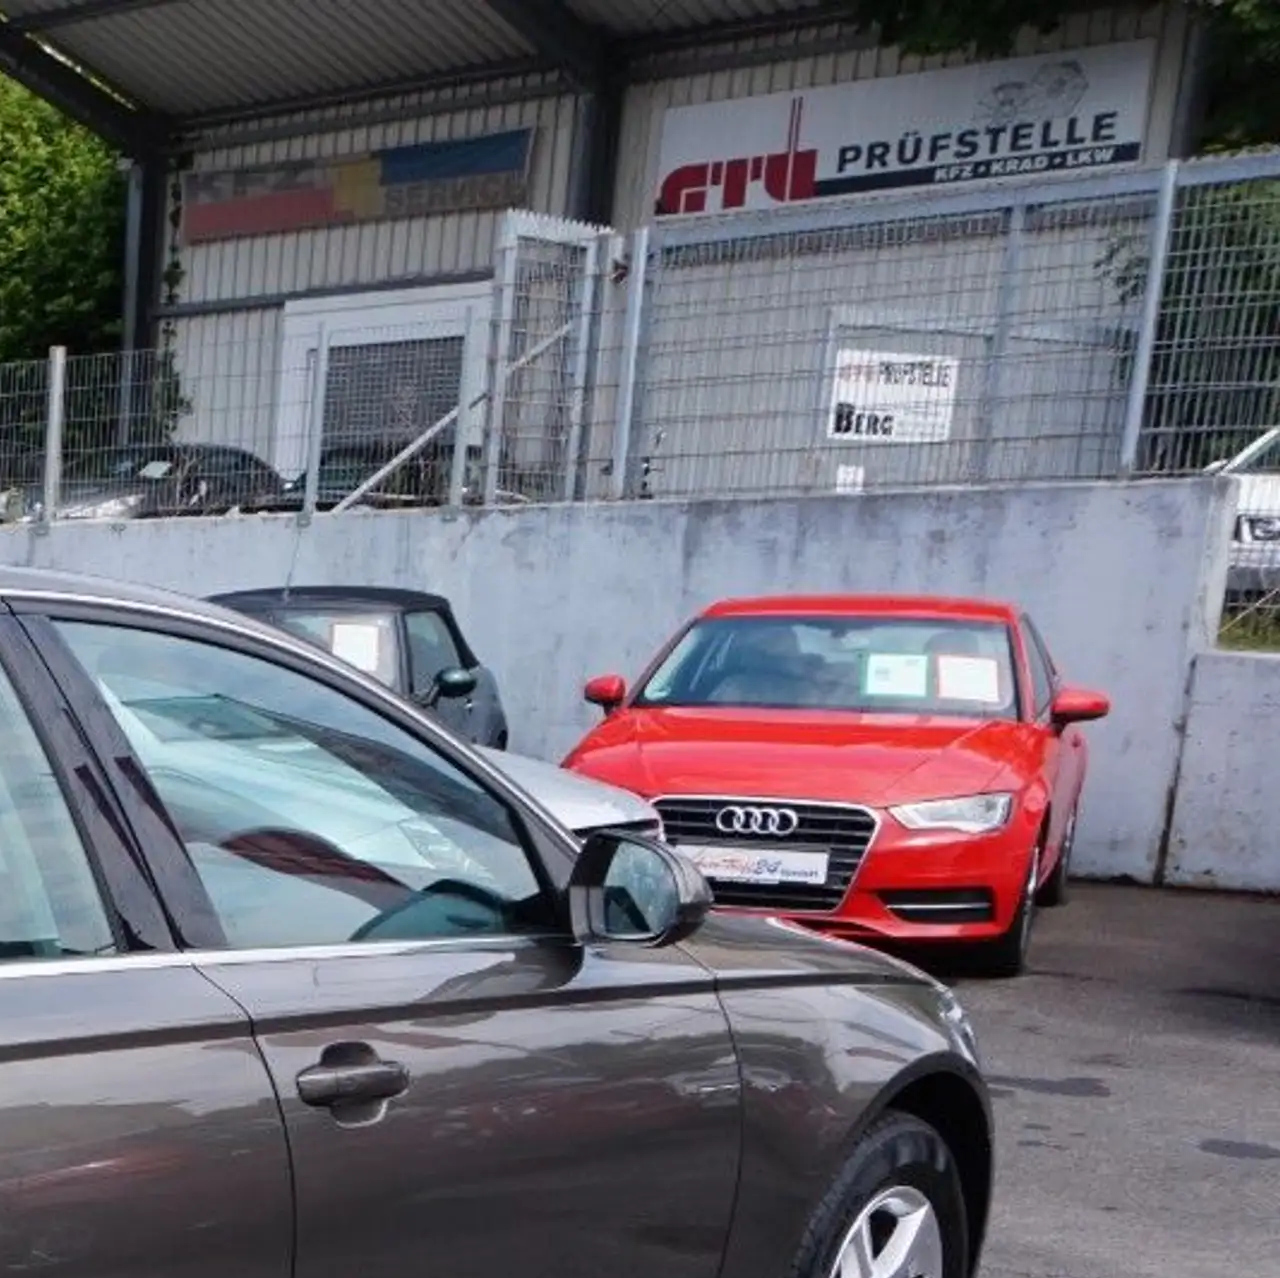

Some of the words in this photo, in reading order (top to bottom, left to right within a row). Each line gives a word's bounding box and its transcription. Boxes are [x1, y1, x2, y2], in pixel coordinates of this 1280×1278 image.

[836, 111, 1118, 174] PRÜFSTELLE
[934, 164, 974, 182] KFZ
[989, 156, 1049, 176] KRAD
[1066, 147, 1116, 167] LKW
